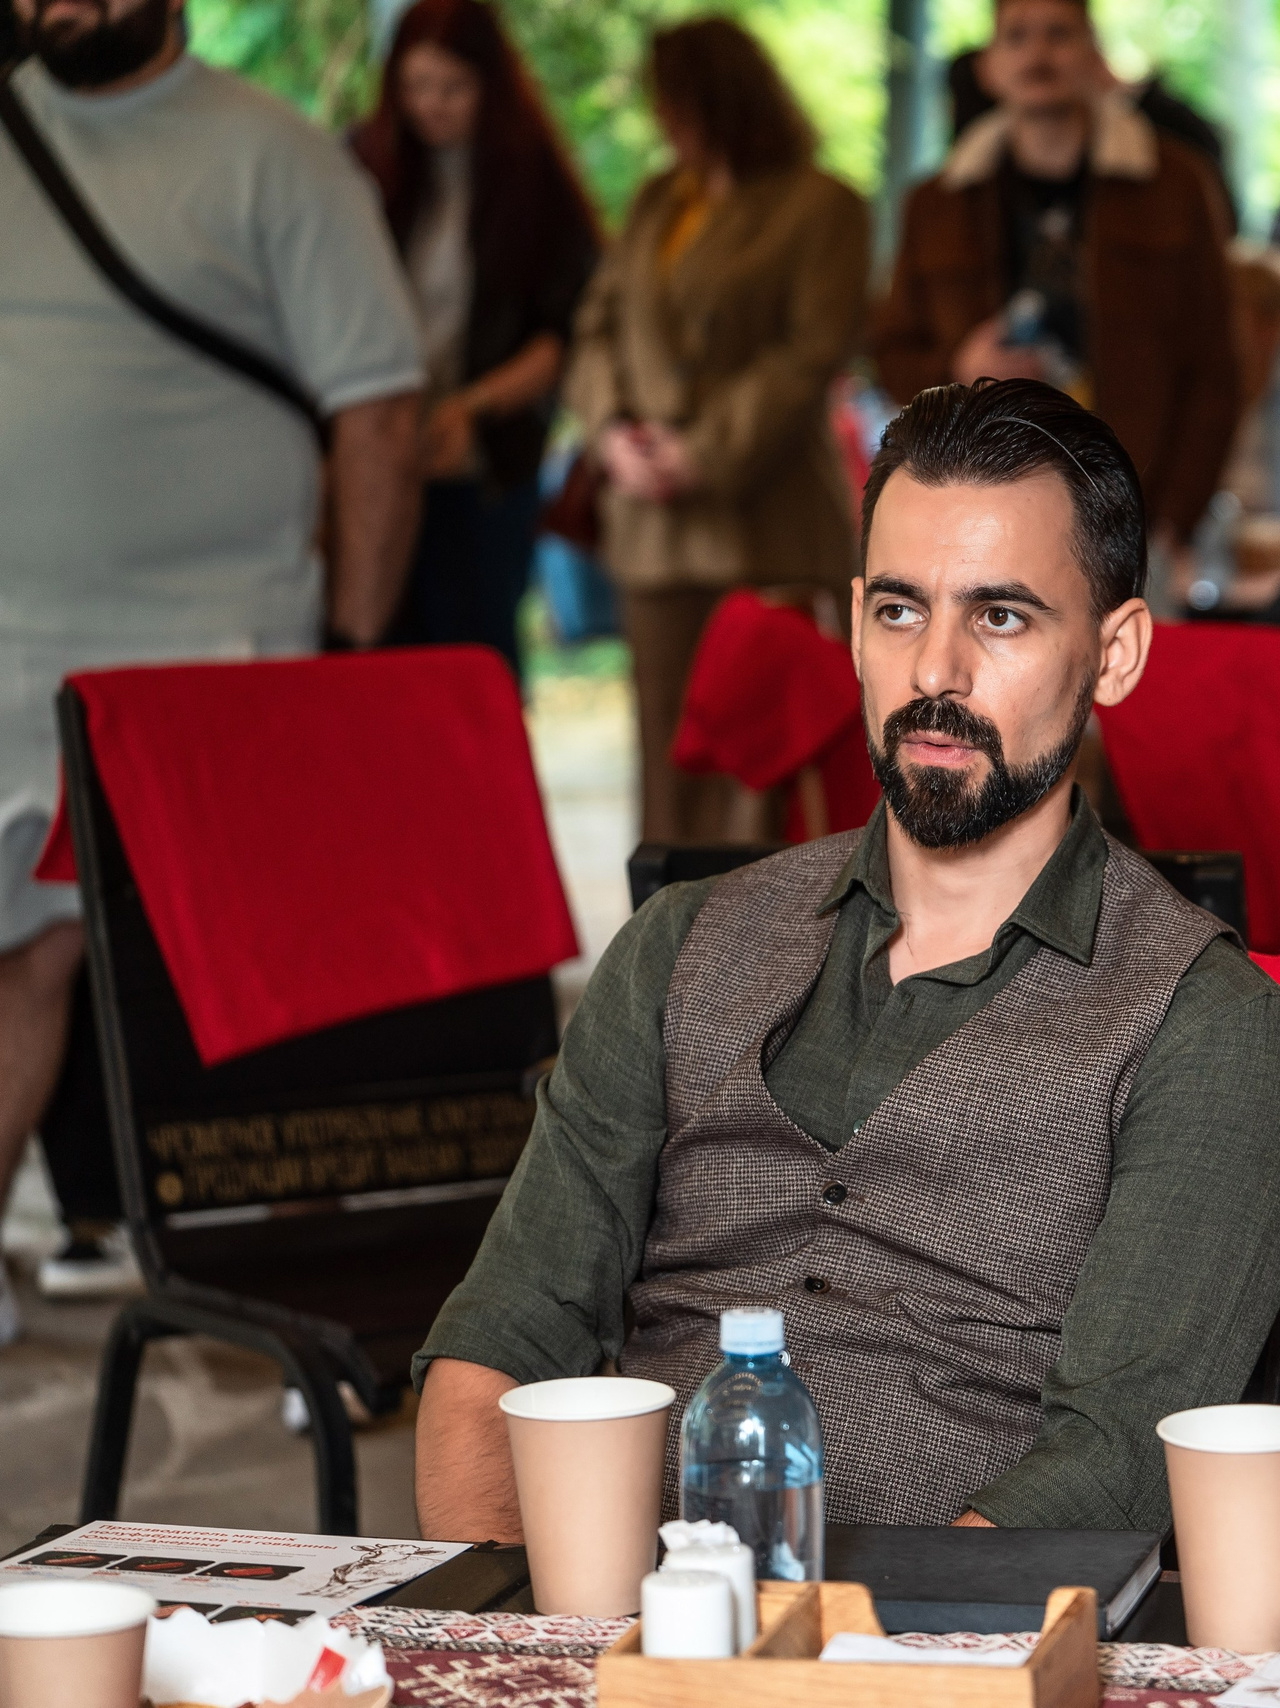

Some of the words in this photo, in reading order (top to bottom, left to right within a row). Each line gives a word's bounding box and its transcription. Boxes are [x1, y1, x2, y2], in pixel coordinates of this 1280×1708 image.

[79, 1534, 144, 1543] Южной
[148, 1539, 222, 1548] Америки
[88, 1530, 229, 1544] полуфабрикатов
[254, 1541, 338, 1550] говядины
[98, 1524, 228, 1537] Производитель
[232, 1533, 297, 1542] мясных
